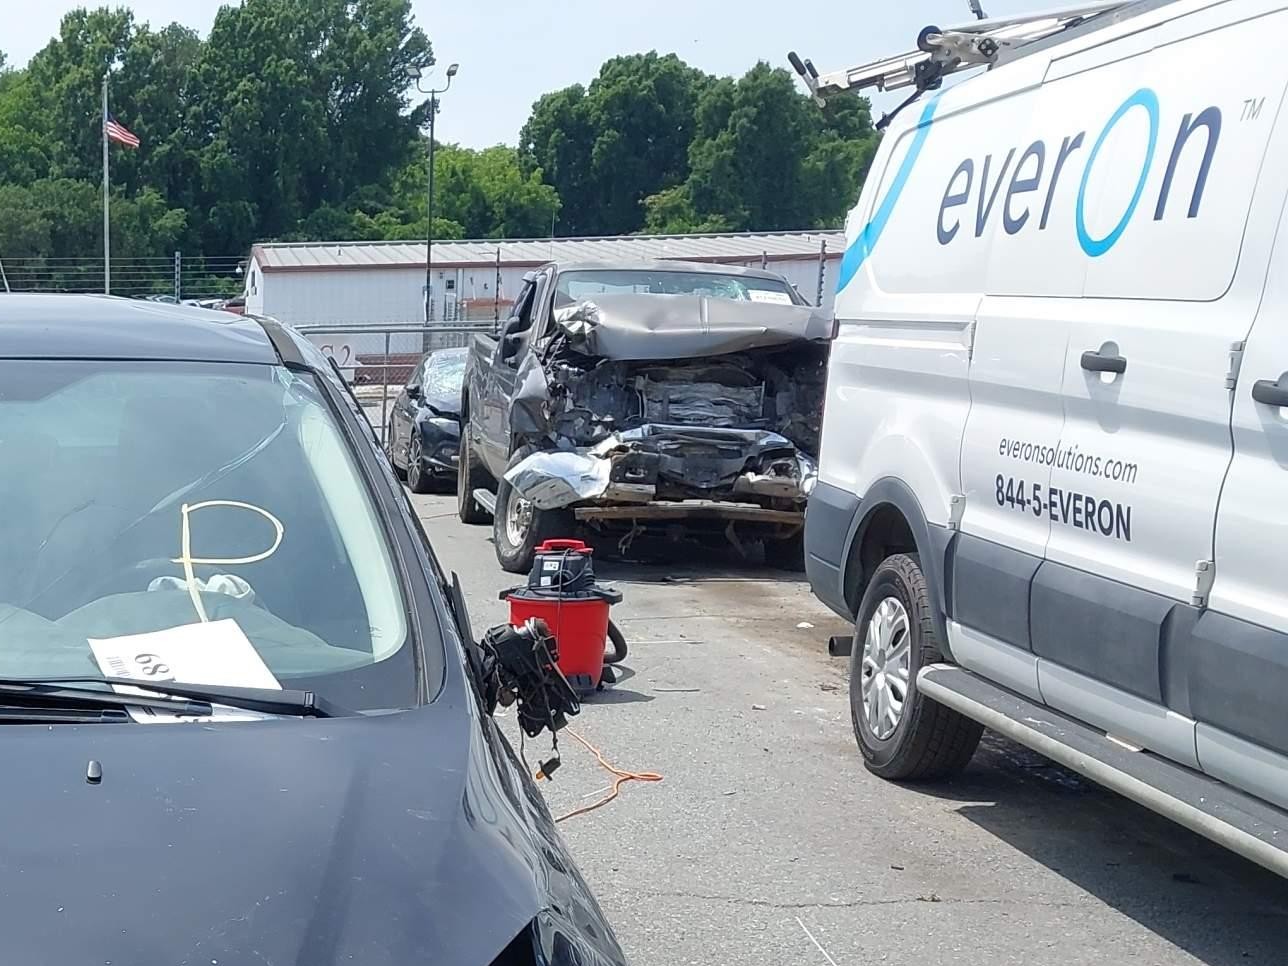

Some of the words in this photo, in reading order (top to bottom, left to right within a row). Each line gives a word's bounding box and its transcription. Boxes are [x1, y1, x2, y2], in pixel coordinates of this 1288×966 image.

[1240, 96, 1266, 122] TM
[999, 438, 1138, 484] everonsolutions.com
[996, 474, 1131, 542] 844-5-EVERON
